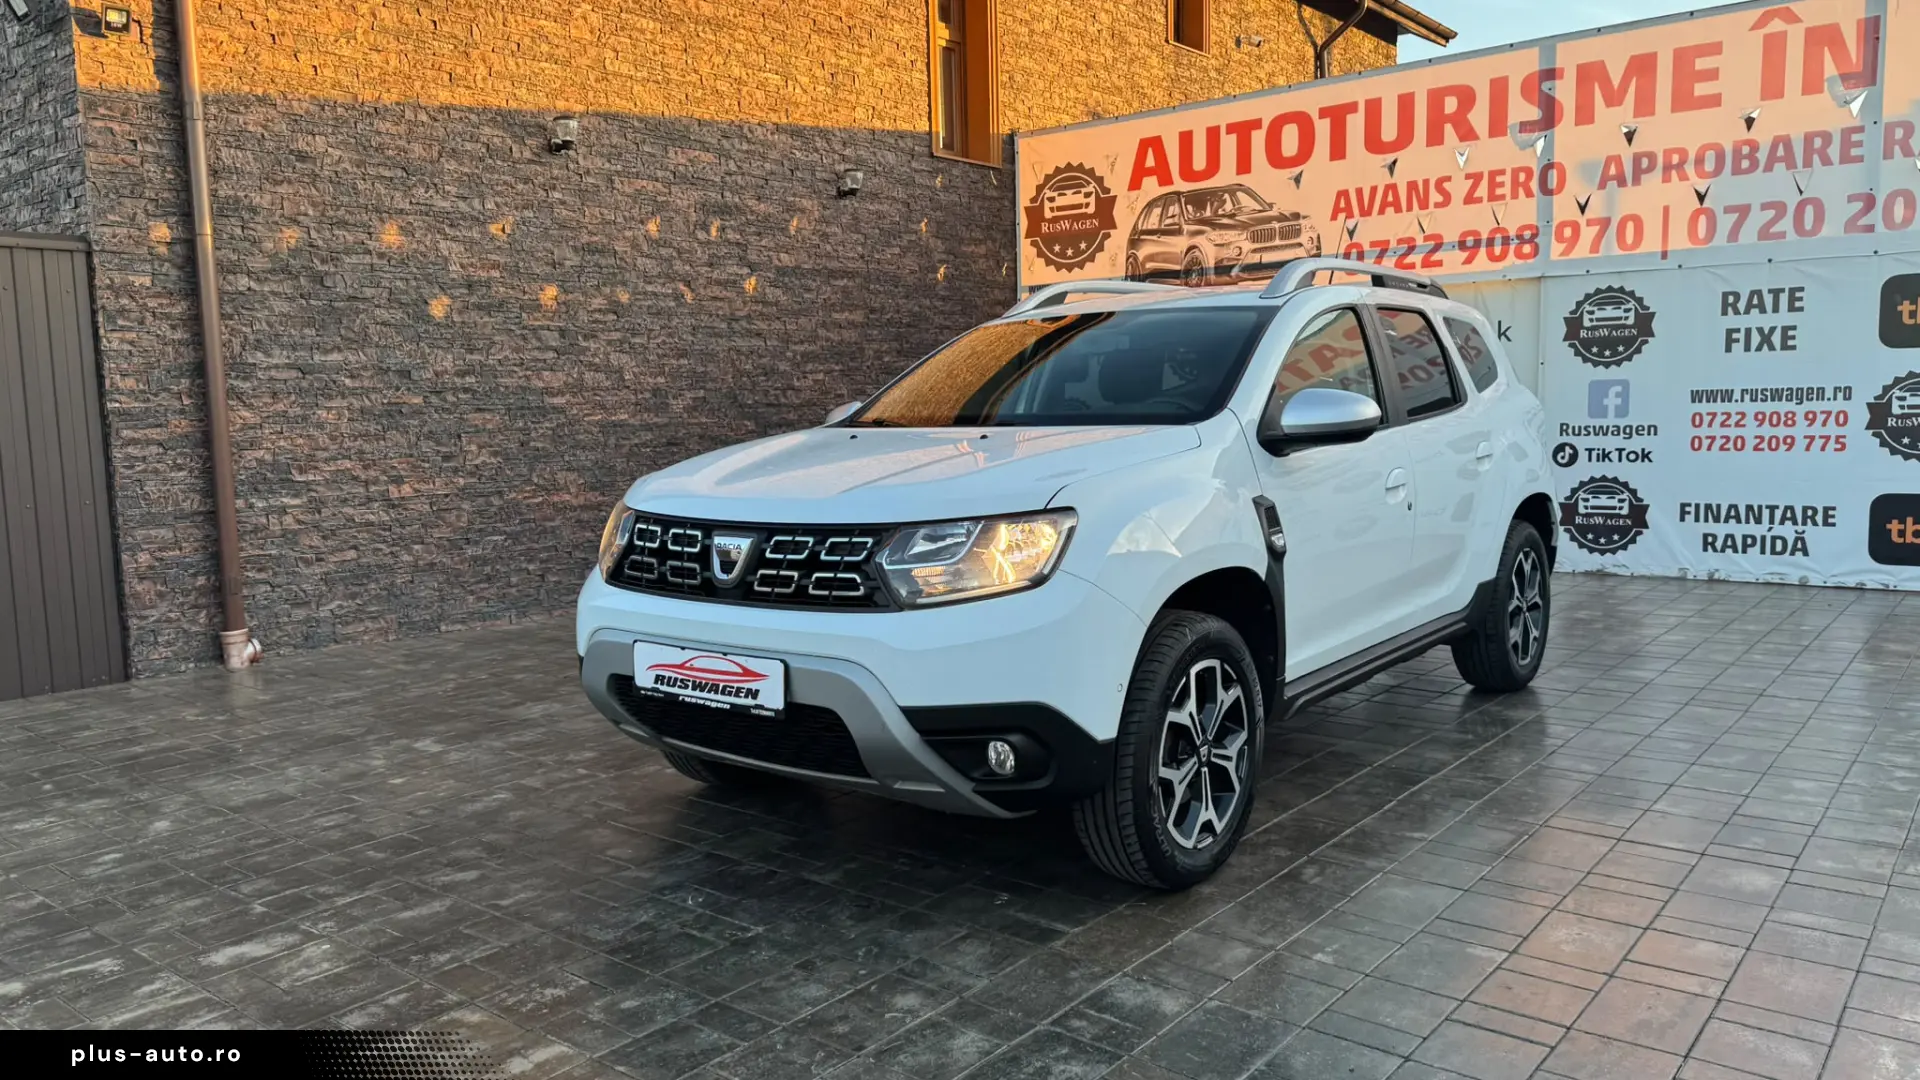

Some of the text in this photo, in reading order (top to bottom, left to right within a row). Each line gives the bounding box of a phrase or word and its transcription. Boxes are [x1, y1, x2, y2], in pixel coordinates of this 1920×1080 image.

[1127, 6, 1882, 191] AUTOTURISME ÎN
[1329, 175, 1452, 222] AVANS
[1463, 161, 1567, 206] ZERO
[1597, 125, 1865, 191] APROBARE
[1343, 232, 1444, 276] 0722
[1458, 223, 1540, 266] 908
[1554, 213, 1644, 258] 970
[1687, 200, 1826, 247] 0720
[1720, 286, 1806, 317] RATE
[1724, 325, 1798, 353] FIXE
[1690, 385, 1853, 405] www.ruswagen.ro
[1559, 422, 1658, 440] Ruswagen
[1690, 410, 1849, 428] 0722 908 970
[1584, 447, 1654, 464] TikTok
[1690, 434, 1847, 453] 0720 209 775
[653, 673, 761, 701] RUSWAGEN
[679, 695, 731, 710] ruswagen
